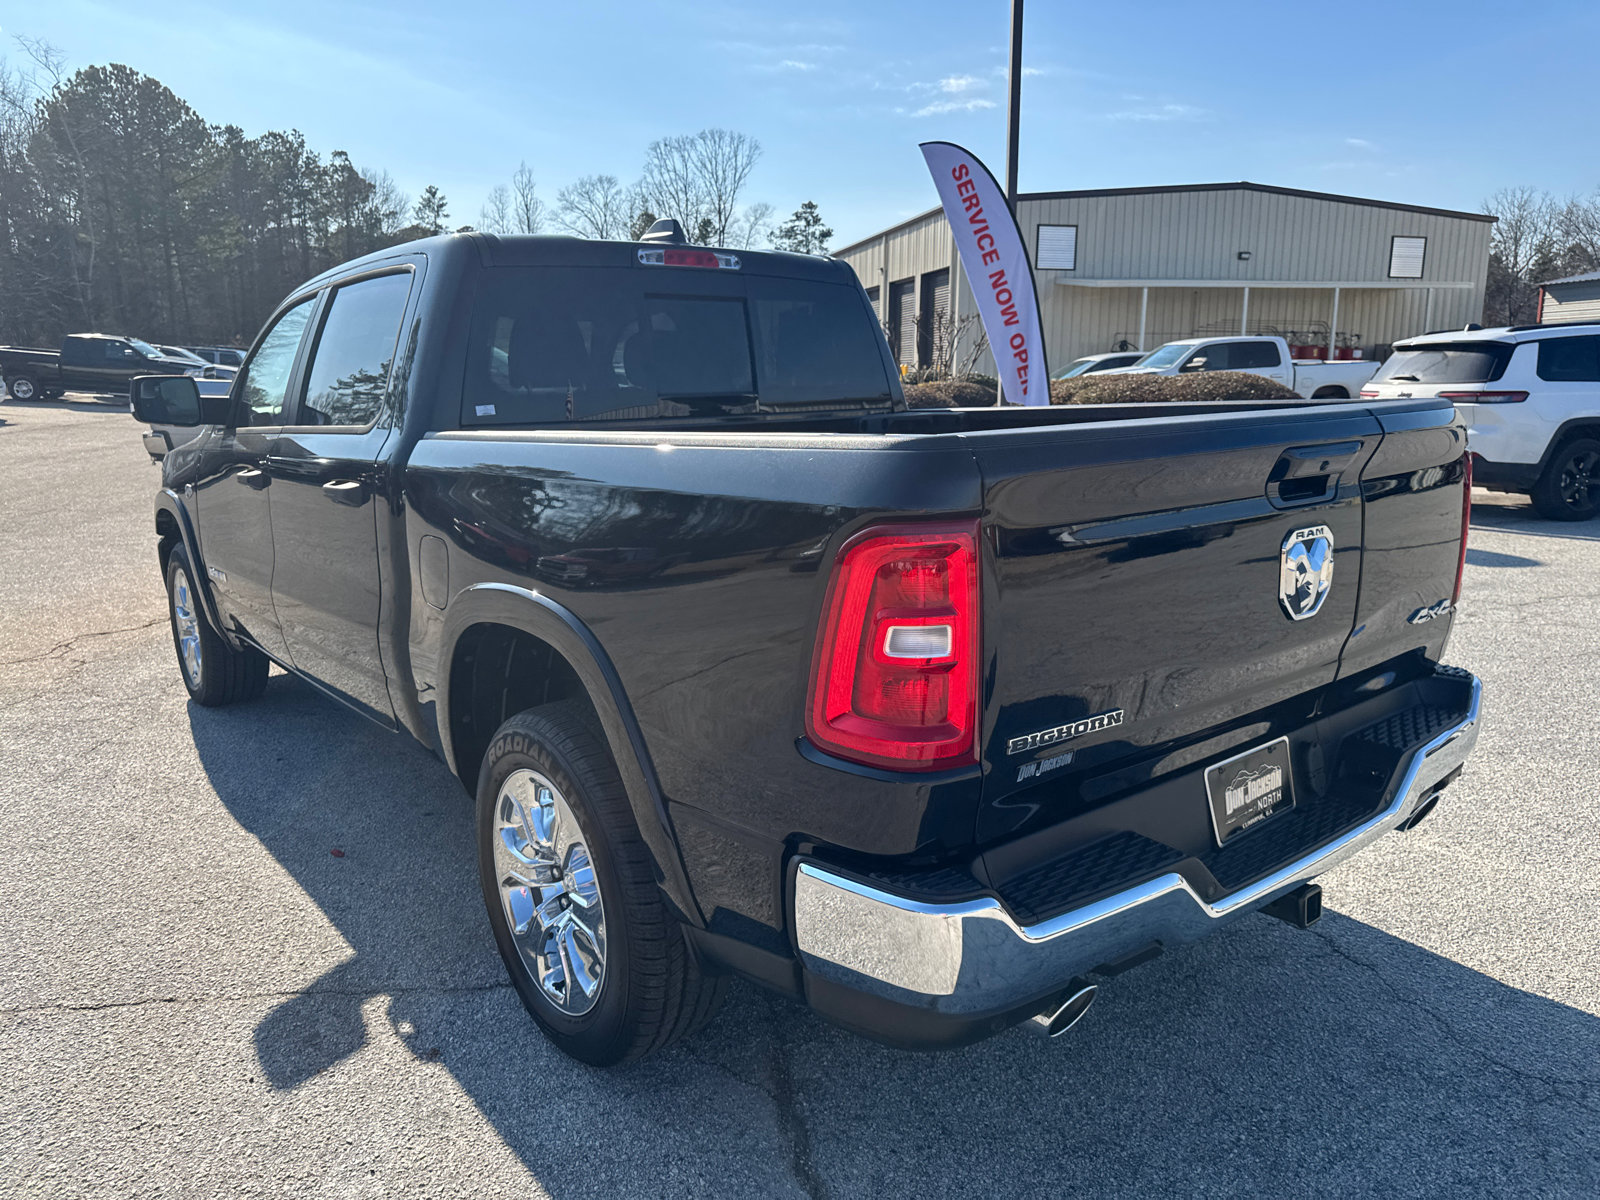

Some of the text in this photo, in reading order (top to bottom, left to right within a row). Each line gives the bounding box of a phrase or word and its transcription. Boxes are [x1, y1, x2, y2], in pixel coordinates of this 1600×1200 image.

[952, 163, 1000, 266] SERVICE
[988, 269, 1020, 327] NOW
[1295, 527, 1324, 539] RAM
[1007, 709, 1123, 755] BIGHORN
[488, 734, 553, 769] ROADIAN
[1257, 789, 1282, 811] NORTH
